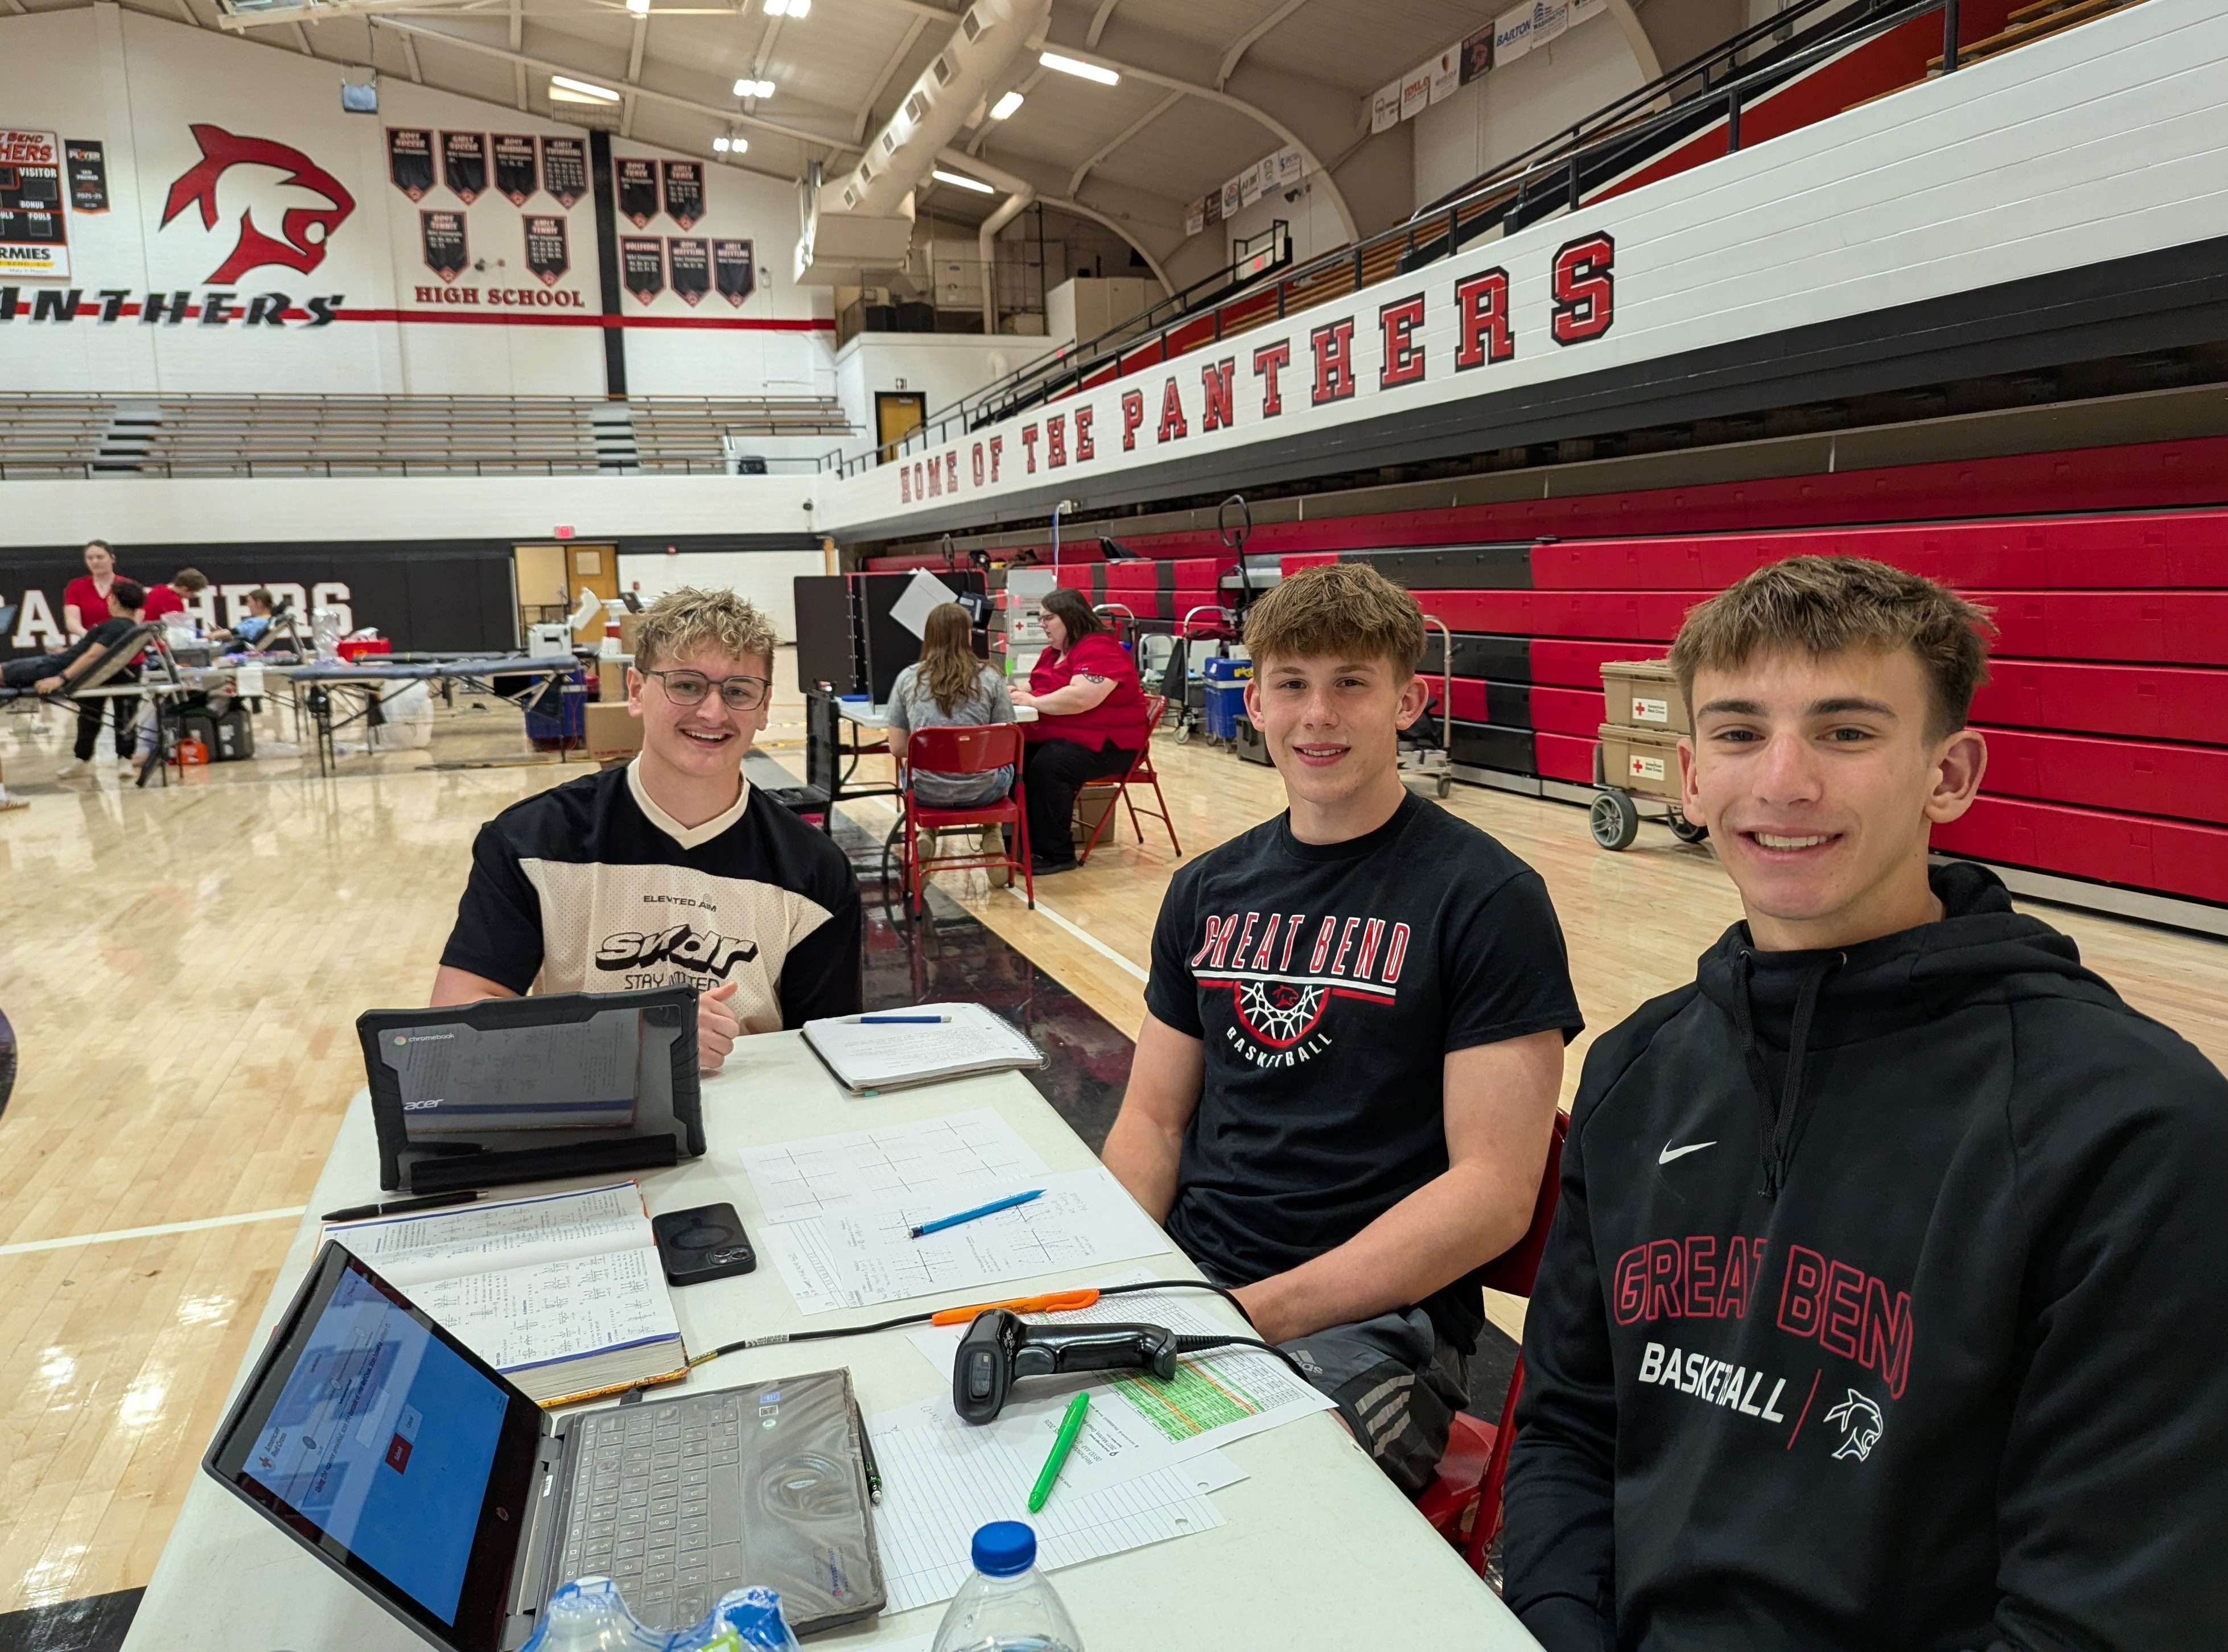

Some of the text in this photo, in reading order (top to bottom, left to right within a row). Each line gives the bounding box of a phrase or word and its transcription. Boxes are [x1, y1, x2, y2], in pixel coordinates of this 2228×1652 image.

[1496, 19, 1531, 47] BARTON
[18, 167, 56, 178] VISITOR
[19, 200, 44, 208] BONUS
[415, 286, 584, 308] HIGH SCHOOL
[900, 233, 1615, 503] HOME OF THE PANTHERS
[1191, 912, 1411, 984] GREAT BEND
[625, 973, 665, 990] STAY
[409, 1032, 455, 1044] chromebook
[1226, 1026, 1332, 1068] BASKETBALL
[404, 1098, 444, 1111] acer
[265, 1427, 281, 1452] American
[270, 1432, 288, 1457] Red Cross
